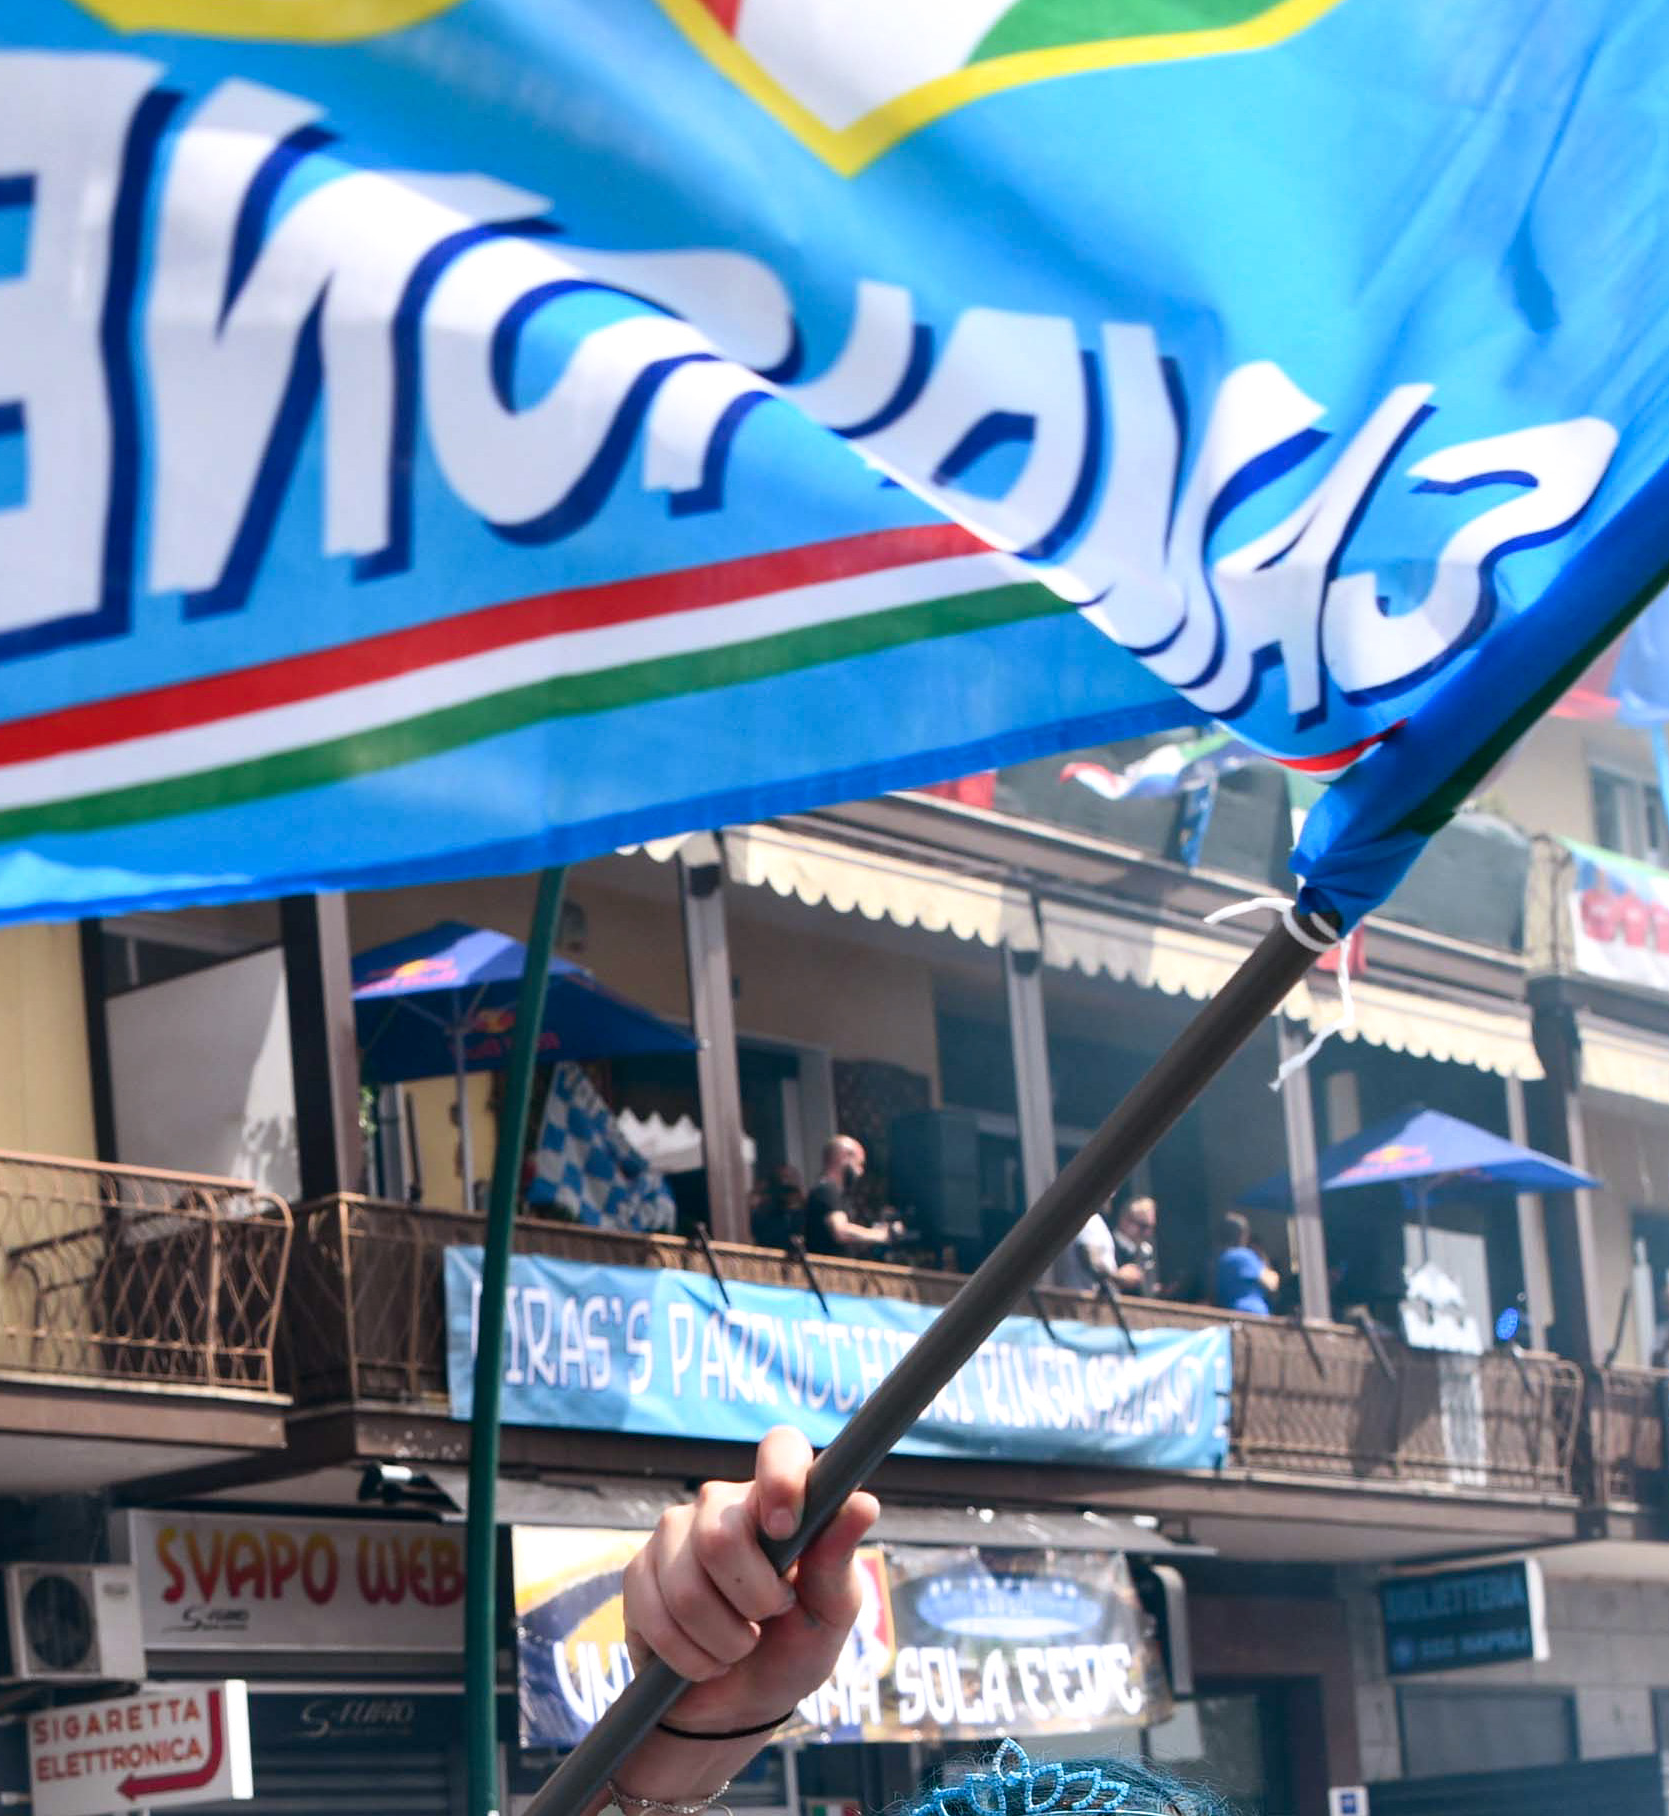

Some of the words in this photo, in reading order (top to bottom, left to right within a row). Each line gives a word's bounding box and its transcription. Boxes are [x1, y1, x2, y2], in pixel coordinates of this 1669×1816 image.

[470, 1280, 654, 1395] IRAS'S
[157, 1526, 338, 1605] SVAPO
[356, 1540, 466, 1607] WEB
[34, 1699, 199, 1745] SIGARETTA
[895, 1646, 1015, 1726] SOLA
[1015, 1642, 1148, 1720] FEDE
[37, 1739, 204, 1781] ELETTRONICA
